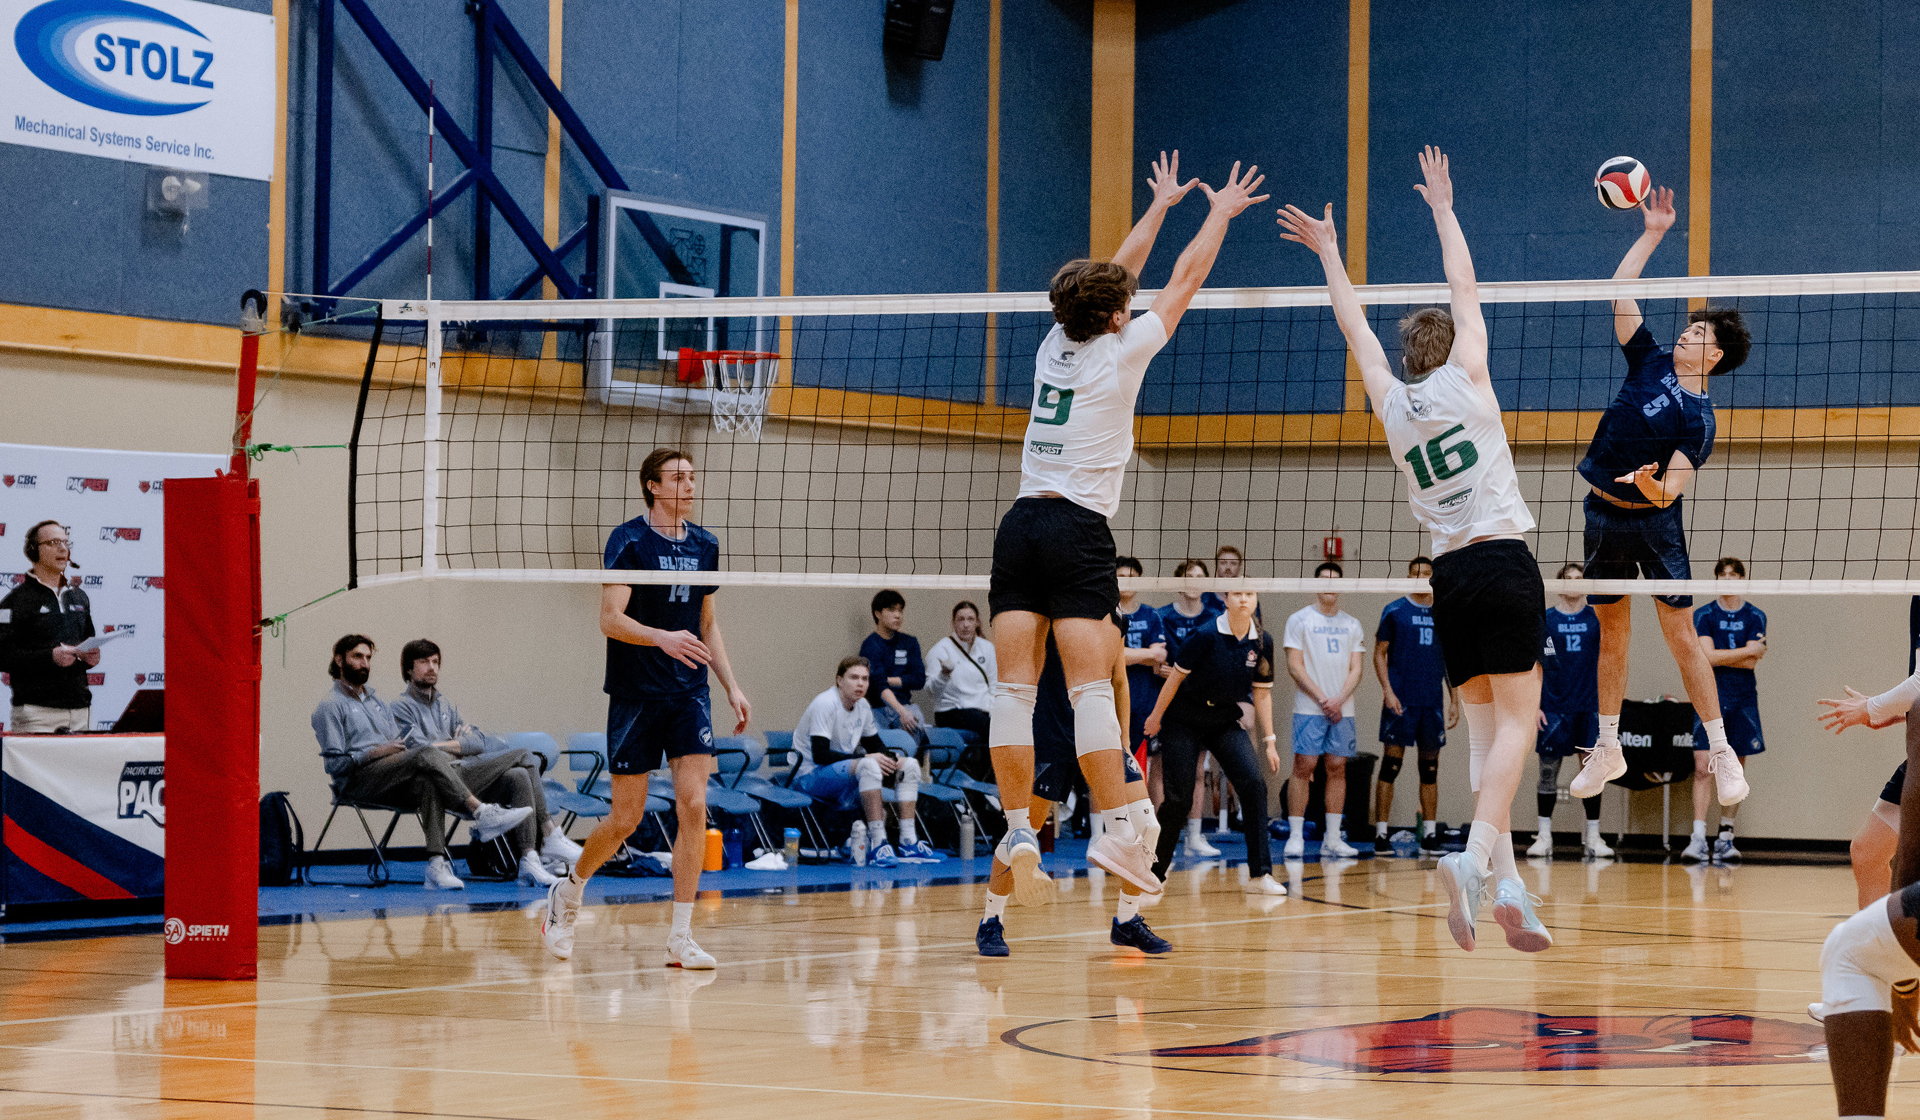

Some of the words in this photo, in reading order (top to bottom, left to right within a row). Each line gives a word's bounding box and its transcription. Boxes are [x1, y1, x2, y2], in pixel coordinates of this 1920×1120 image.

[94, 33, 214, 89] STOLZ
[14, 115, 86, 141] Mechanical
[89, 127, 142, 149] Systems
[145, 136, 190, 156] Service
[194, 142, 215, 160] Inc.
[1034, 383, 1075, 426] 9
[1643, 393, 1670, 417] 5
[1404, 424, 1479, 490] 16
[17, 475, 37, 485] CBC
[658, 555, 699, 571] BLUES
[84, 575, 103, 585] CBC
[669, 584, 690, 603] 14
[1419, 627, 1434, 646] 19
[1558, 622, 1588, 633] BLUES
[1326, 637, 1340, 654] 13
[1565, 634, 1582, 652] 12
[123, 766, 149, 776] PACIFIC
[186, 924, 230, 937] SPIETH
